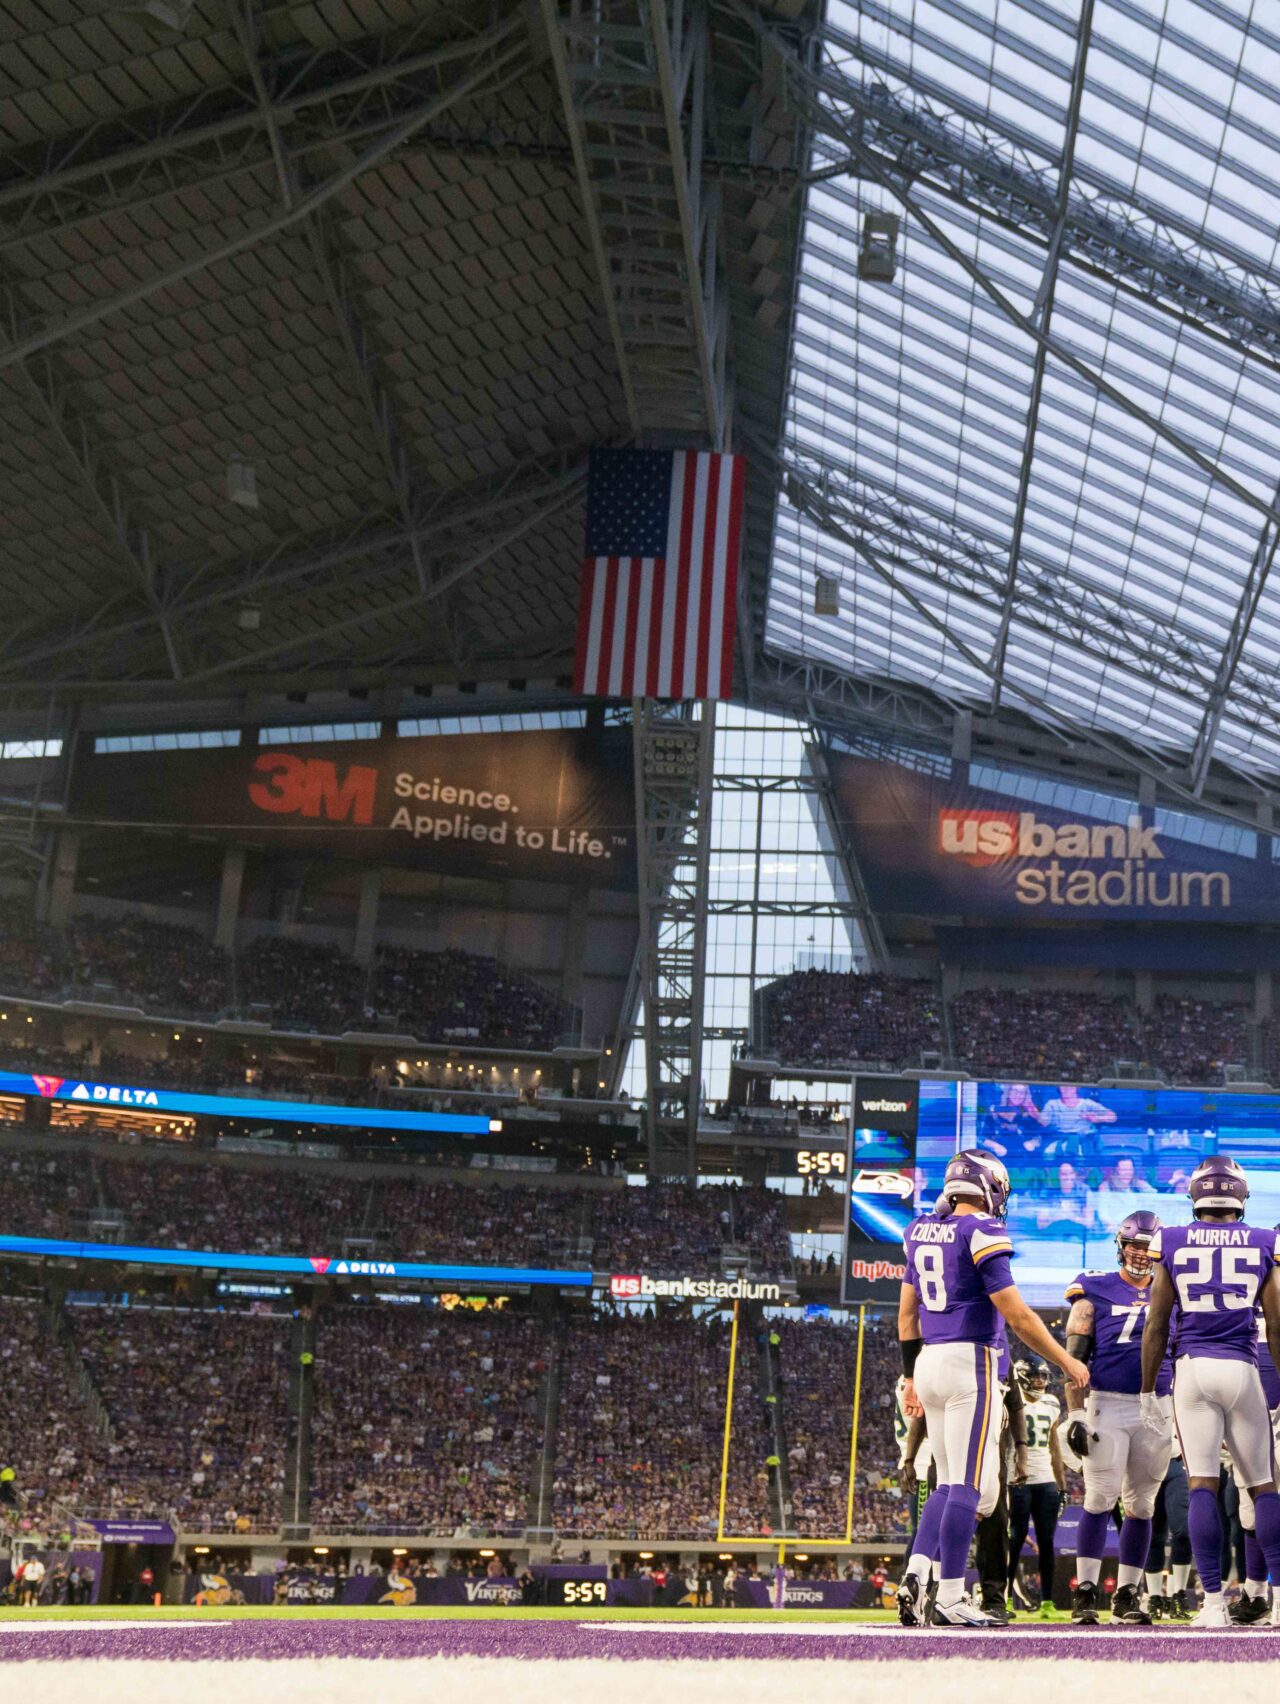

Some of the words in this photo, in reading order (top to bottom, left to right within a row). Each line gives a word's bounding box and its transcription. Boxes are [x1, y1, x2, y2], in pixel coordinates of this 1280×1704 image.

[247, 752, 378, 826] 3M
[393, 772, 519, 814] Science.
[389, 805, 507, 846] Applied
[515, 825, 544, 850] to
[1015, 859, 1230, 907] stadium
[93, 1085, 159, 1106] DELTA
[862, 1099, 907, 1113] verizon
[797, 1151, 846, 1174] 5:59
[910, 1223, 958, 1243] COUSINS
[1186, 1229, 1251, 1246] MURRAY
[350, 1262, 396, 1275] DELTA
[914, 1245, 947, 1312] 8
[1173, 1247, 1261, 1313] 25
[1111, 1304, 1151, 1344] 7
[464, 1581, 523, 1601] VIKINGS
[564, 1582, 606, 1602] 5:59
